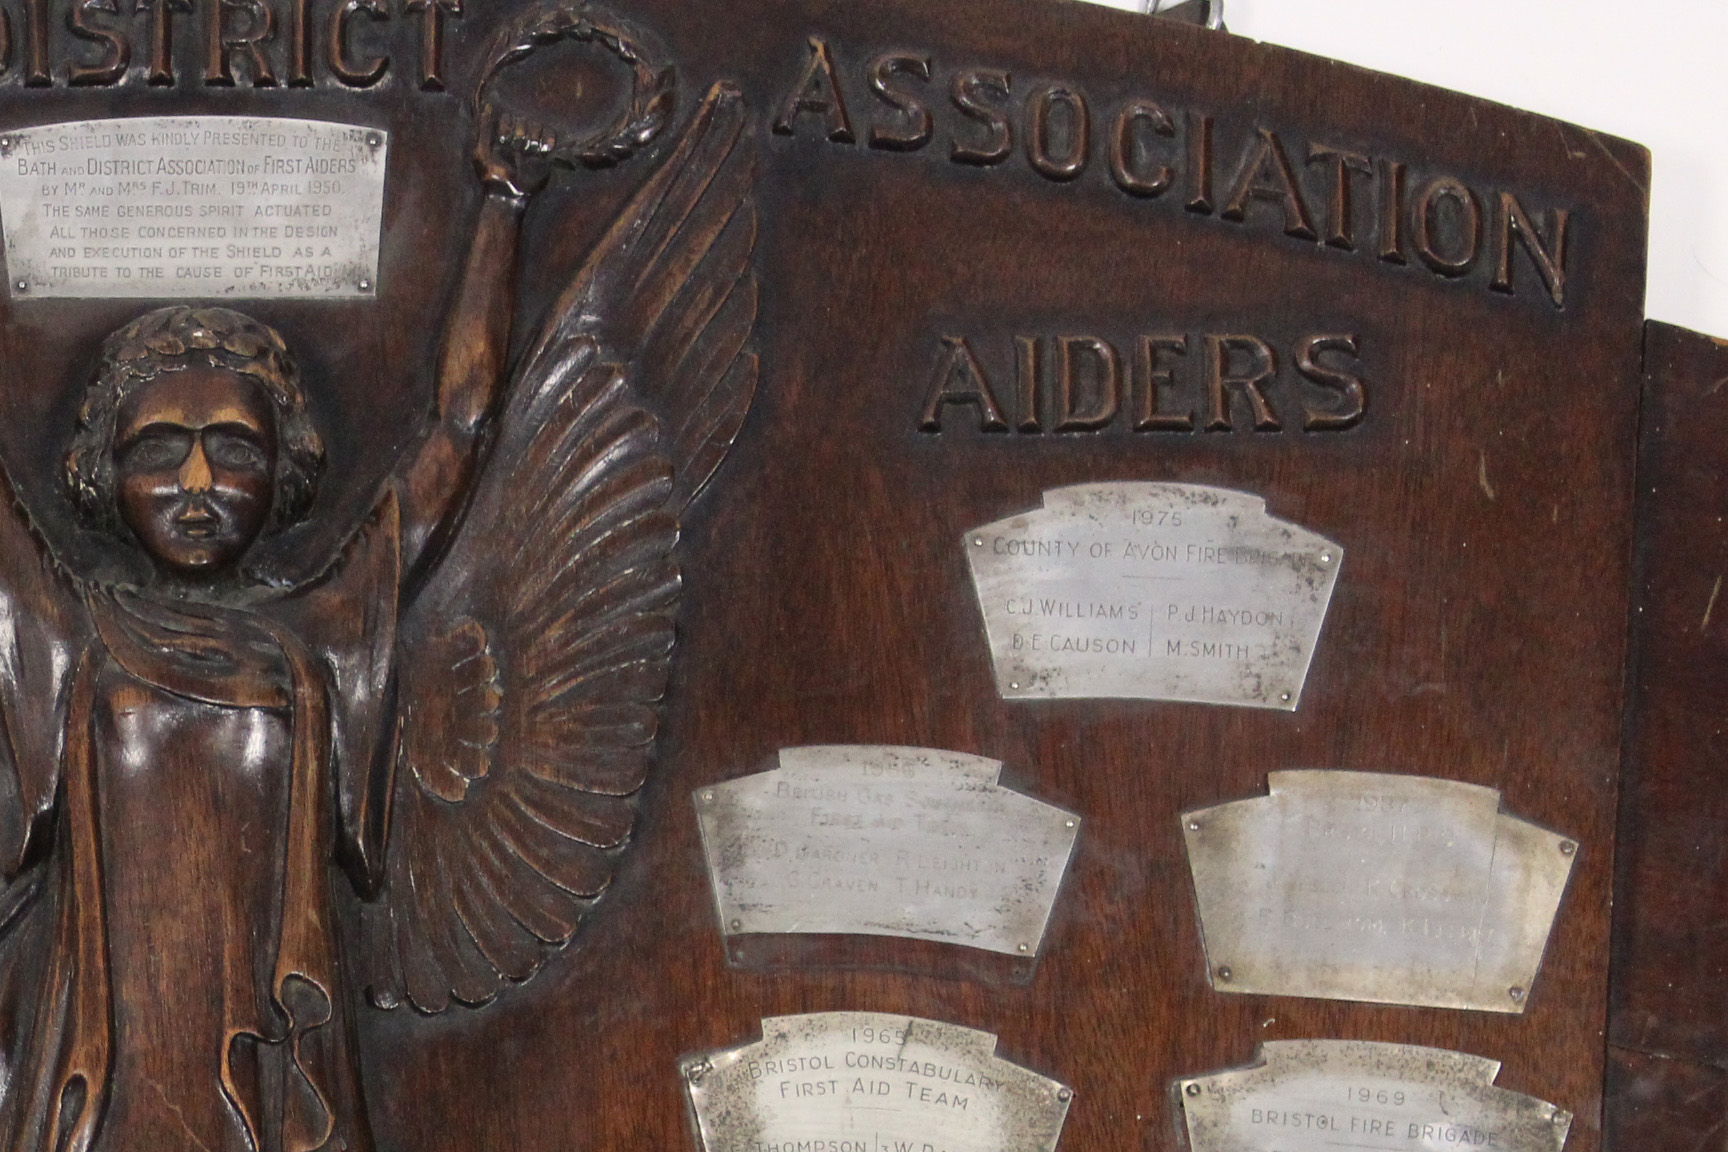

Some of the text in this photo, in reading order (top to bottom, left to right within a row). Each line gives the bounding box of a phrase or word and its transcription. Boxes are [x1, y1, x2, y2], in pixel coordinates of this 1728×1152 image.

[18, 157, 356, 176] BATH AND DISTRICT ASSOCIATION FIRST AIDERS
[771, 35, 1571, 309] ASSOCIATION
[42, 185, 59, 196] BY
[90, 187, 113, 196] AND
[261, 181, 303, 195] APRIL
[43, 204, 332, 218] THE SAME GENEROUS SPIRIT ACTUATED
[50, 225, 338, 239] ALL THOSE CONCERNED IN THE DESIGN
[49, 245, 331, 258] AND EXECUTION OF THE SHIELD AS A
[51, 264, 332, 278] TRIBUTE TO THE CAUSE OF FIRST AID
[918, 332, 1369, 433] AIDERS
[993, 538, 1226, 565] COUNTY OF AVON FIRE
[748, 1050, 1006, 1092] BRISTOL CONSTABULARY
[781, 1077, 968, 1111] FIRST AID TEAM
[1348, 1087, 1405, 1106] 1969
[1351, 1117, 1394, 1137] FIRE
[1408, 1124, 1498, 1147] BRIGADE
